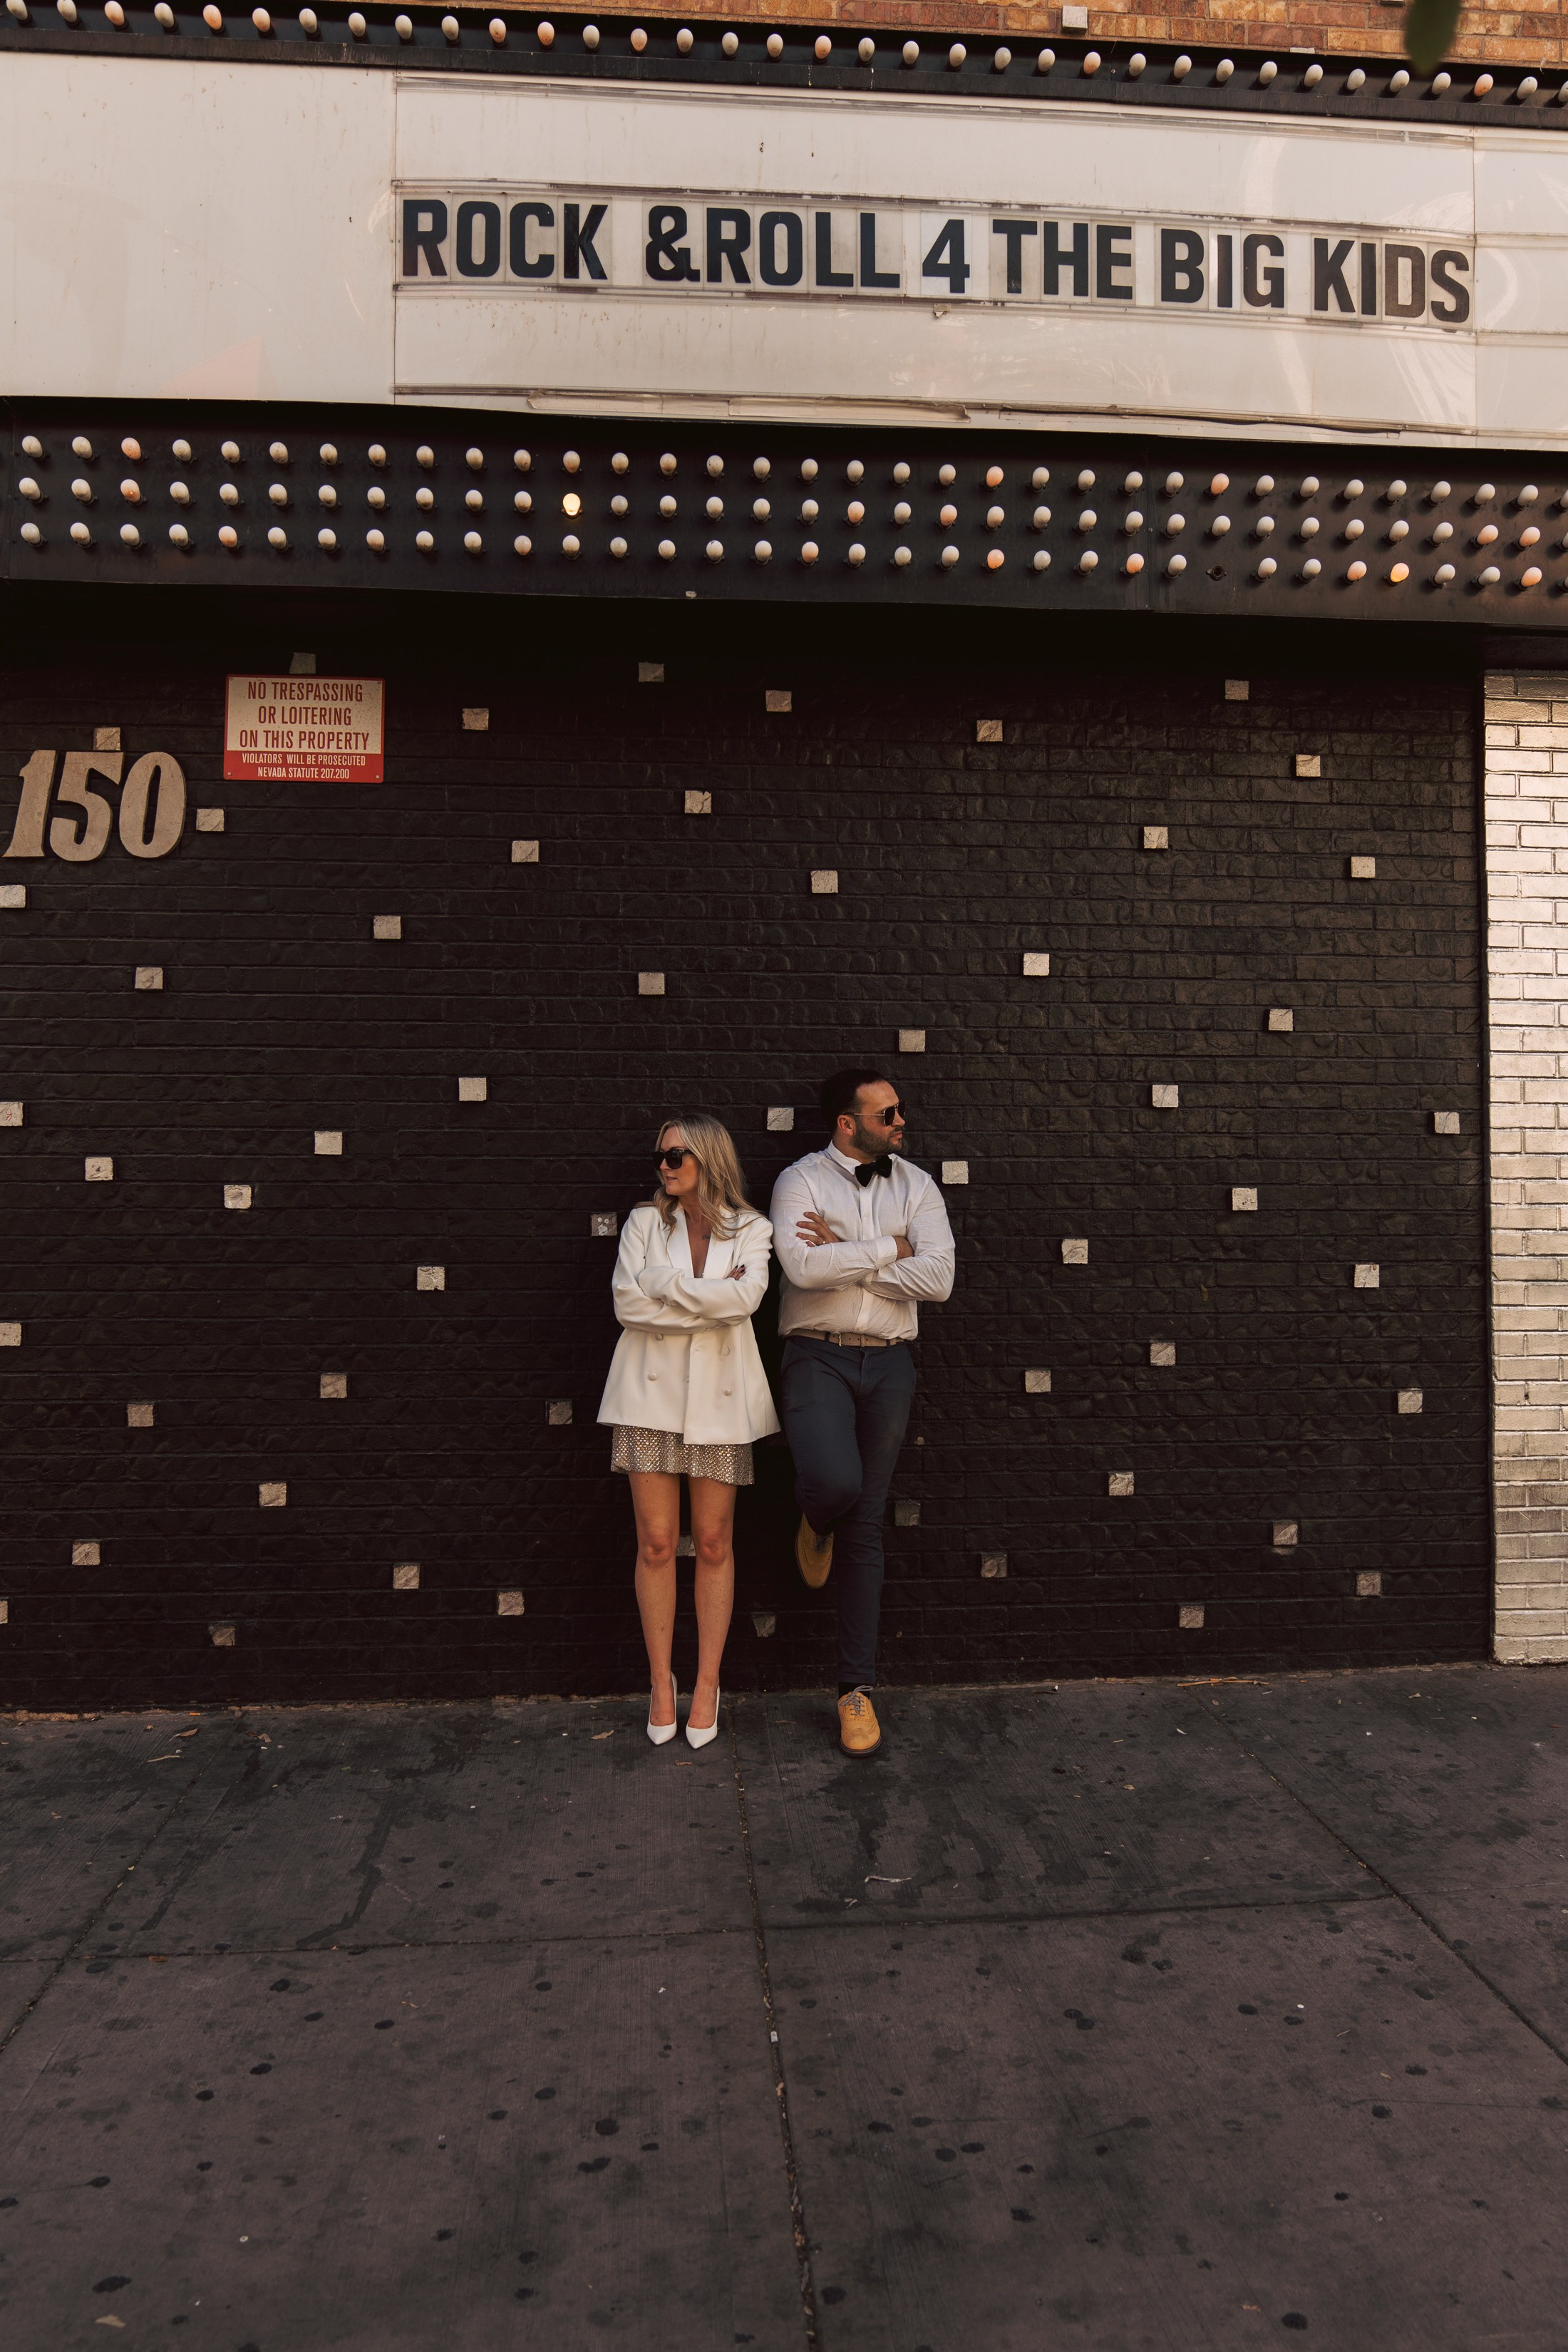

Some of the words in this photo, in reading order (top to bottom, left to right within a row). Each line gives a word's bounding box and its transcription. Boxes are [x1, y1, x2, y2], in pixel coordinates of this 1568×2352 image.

[403, 199, 608, 280] ROCK
[922, 219, 970, 294] 4
[992, 219, 1133, 300] THE
[1160, 228, 1285, 309] BIG
[1314, 237, 1470, 323] KIDS
[248, 681, 266, 699] NO
[272, 682, 363, 701] TRESPASSING
[258, 706, 277, 724] OR
[282, 706, 351, 726] LOITERING
[239, 730, 258, 748] ON
[263, 731, 294, 748] THIS
[299, 731, 370, 751] PROPERTY
[242, 753, 282, 764] VIOLATORS
[287, 754, 304, 765] WILL
[306, 755, 316, 765] BE
[318, 755, 366, 766] PROSECUTED
[257, 767, 287, 778] NEVADA
[288, 768, 319, 778] STATUTE
[321, 768, 350, 779] 207.200
[3, 750, 187, 862] 150
